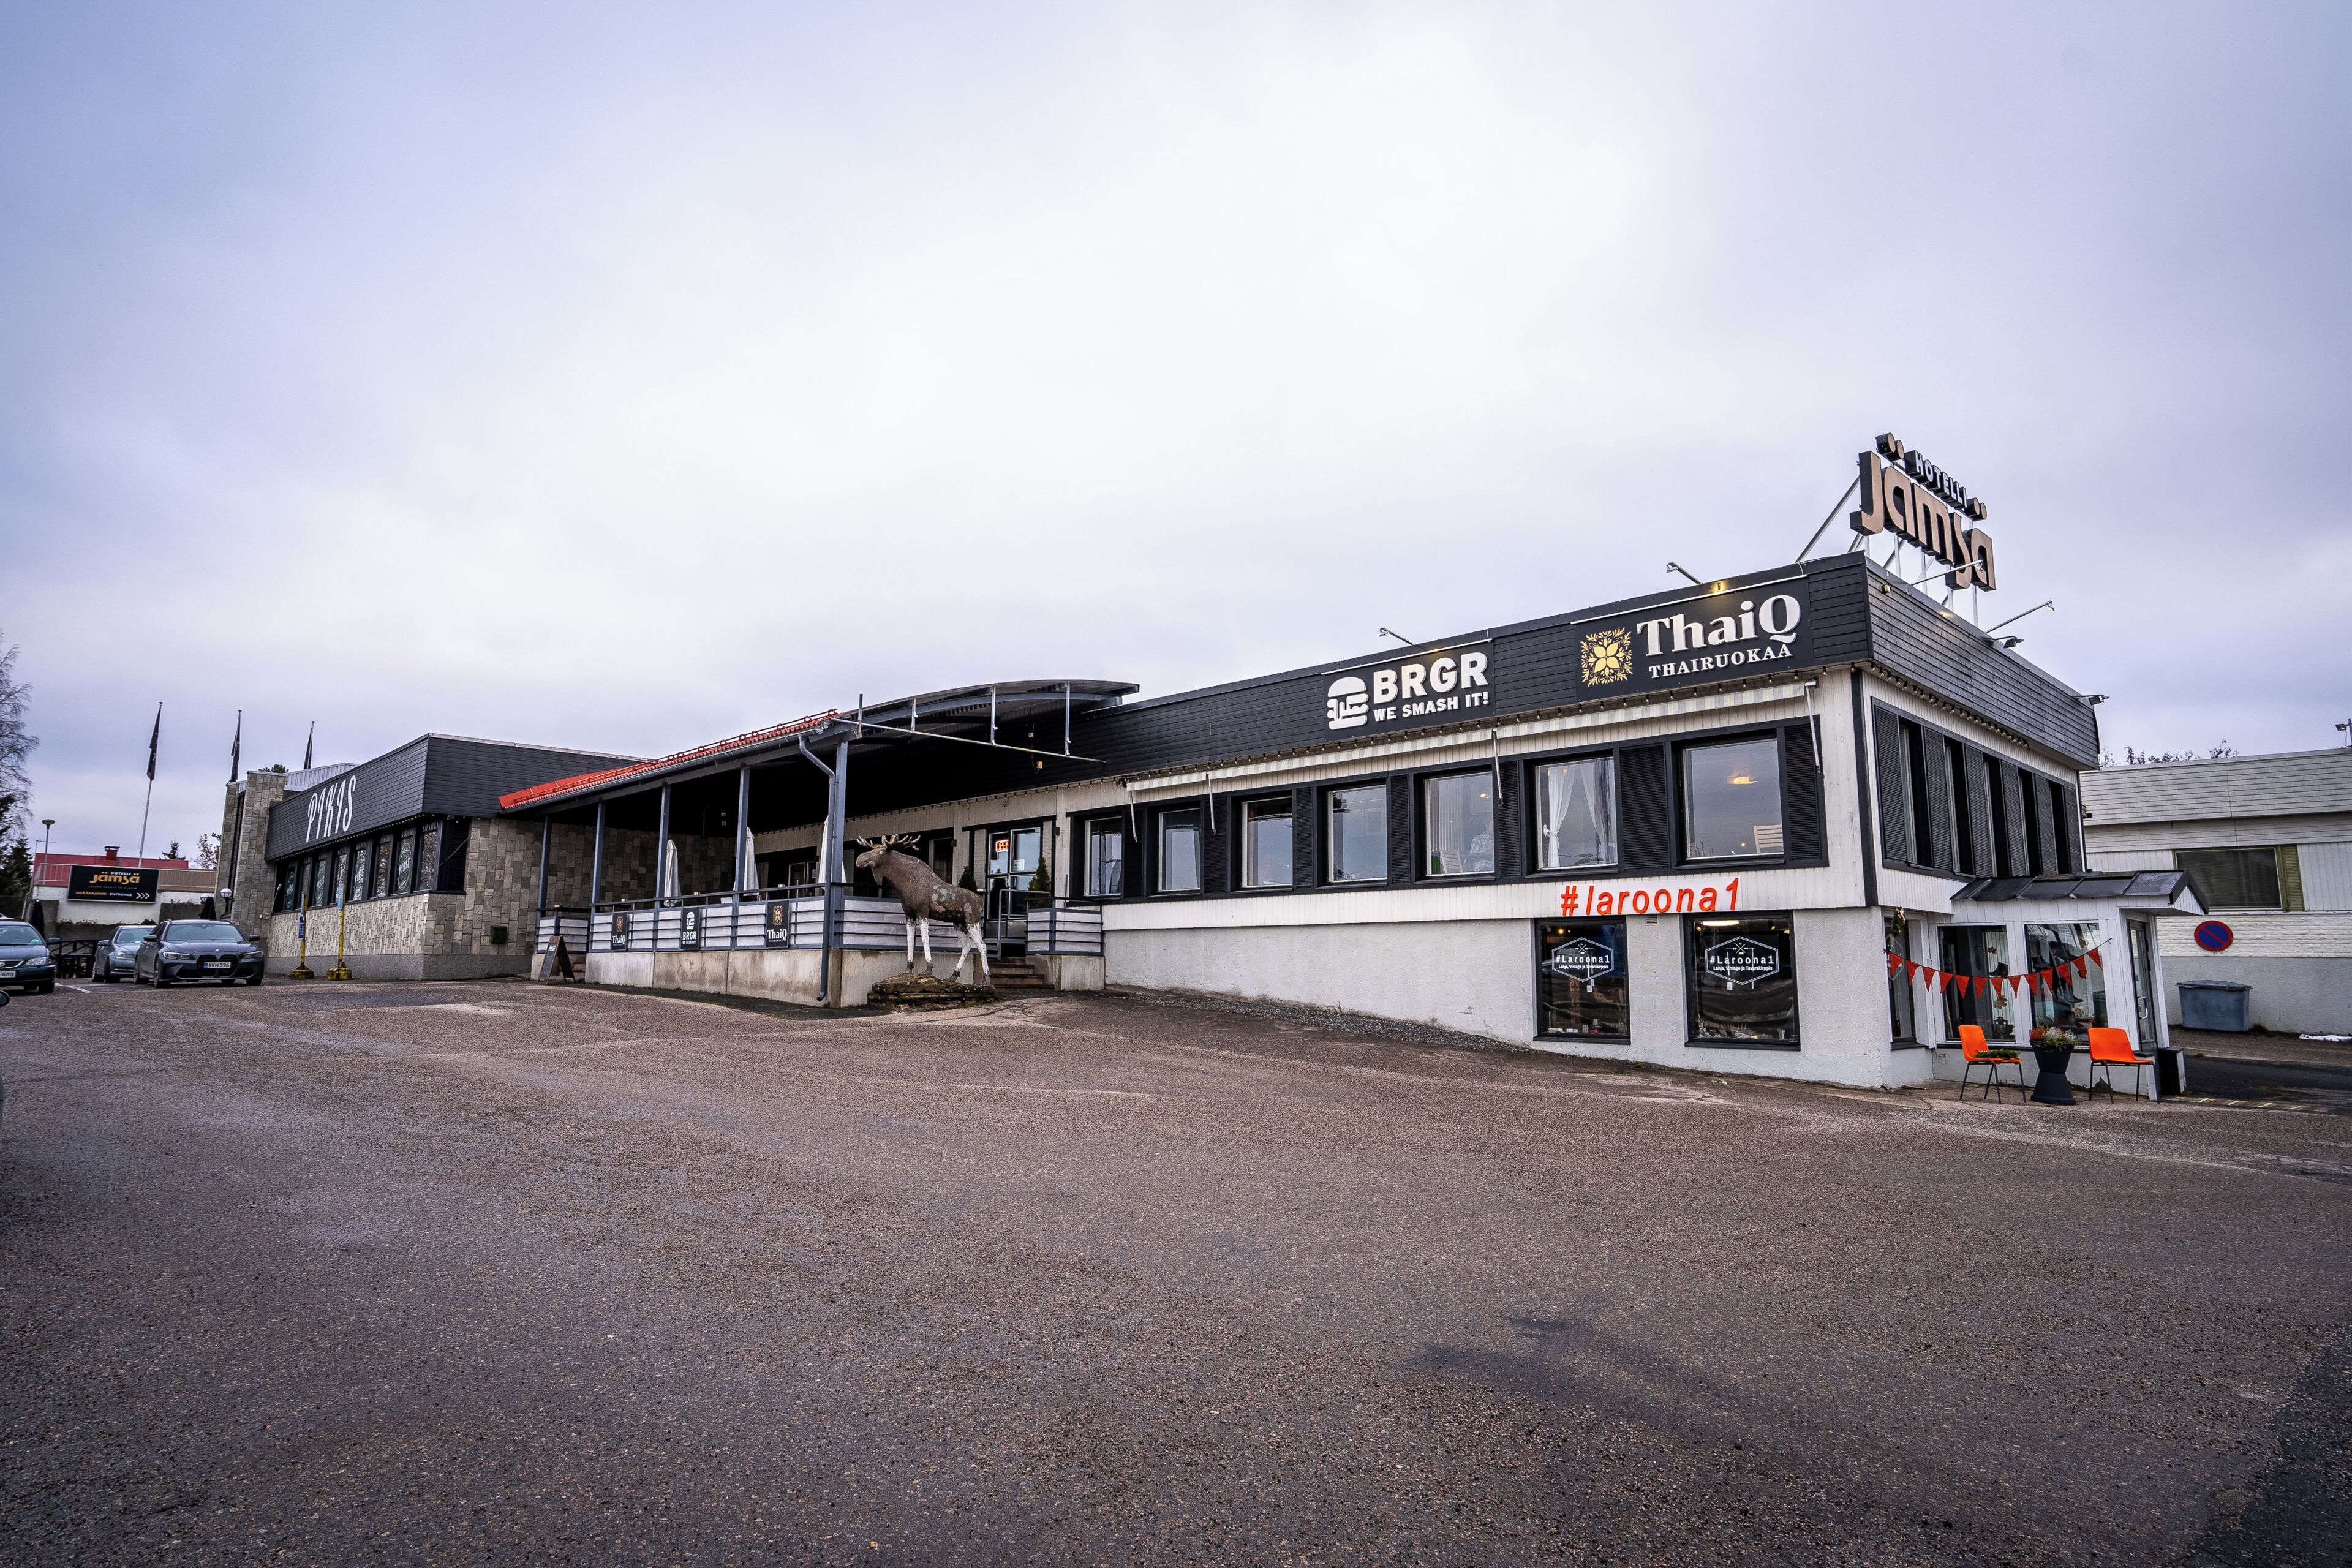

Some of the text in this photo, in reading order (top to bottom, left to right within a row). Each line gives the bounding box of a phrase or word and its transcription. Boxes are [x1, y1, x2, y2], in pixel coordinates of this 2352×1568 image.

[1906, 450, 1967, 510] HOTELLI
[1637, 595, 1801, 657] ThaiQ
[1373, 652, 1489, 704] BRGR
[1649, 644, 1793, 679] THAIRUOKAA
[1373, 691, 1490, 722] WE SMASH IT!
[306, 775, 356, 843] PIKIS
[1561, 878, 1740, 917] #laroona1
[612, 935, 626, 945] ThaiQ
[682, 931, 697, 940] BRGR
[767, 928, 788, 941] ThaiQ
[1709, 956, 1774, 964] #Laroona1
